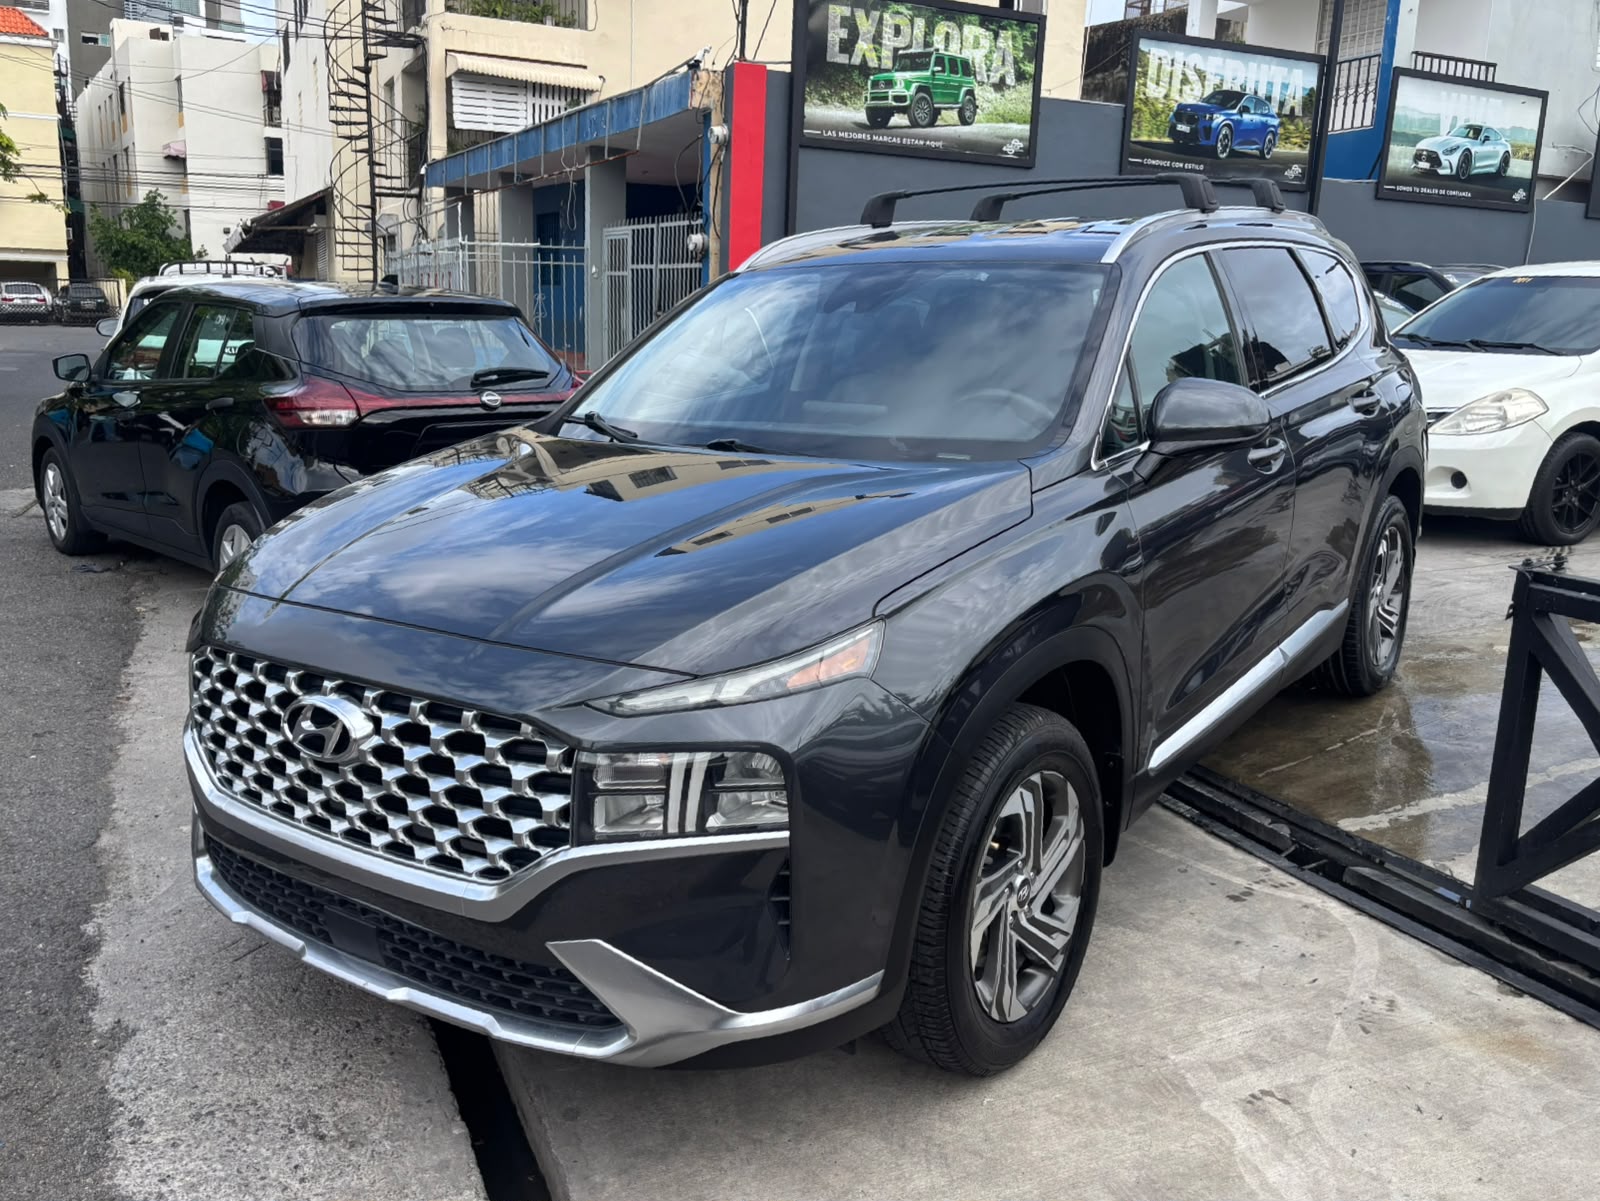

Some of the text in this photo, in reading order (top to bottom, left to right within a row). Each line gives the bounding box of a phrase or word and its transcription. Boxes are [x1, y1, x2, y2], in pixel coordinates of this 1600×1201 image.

[826, 4, 1016, 86] EXPLORA
[1146, 47, 1303, 116] DISFRUTA
[822, 129, 837, 137] LAS
[838, 131, 871, 141] MEJORES
[872, 135, 901, 144] MARCAS
[1143, 158, 1170, 167] CONDUCE
[1420, 187, 1438, 195] DEALER
[1446, 190, 1472, 198] CONFIANZA
